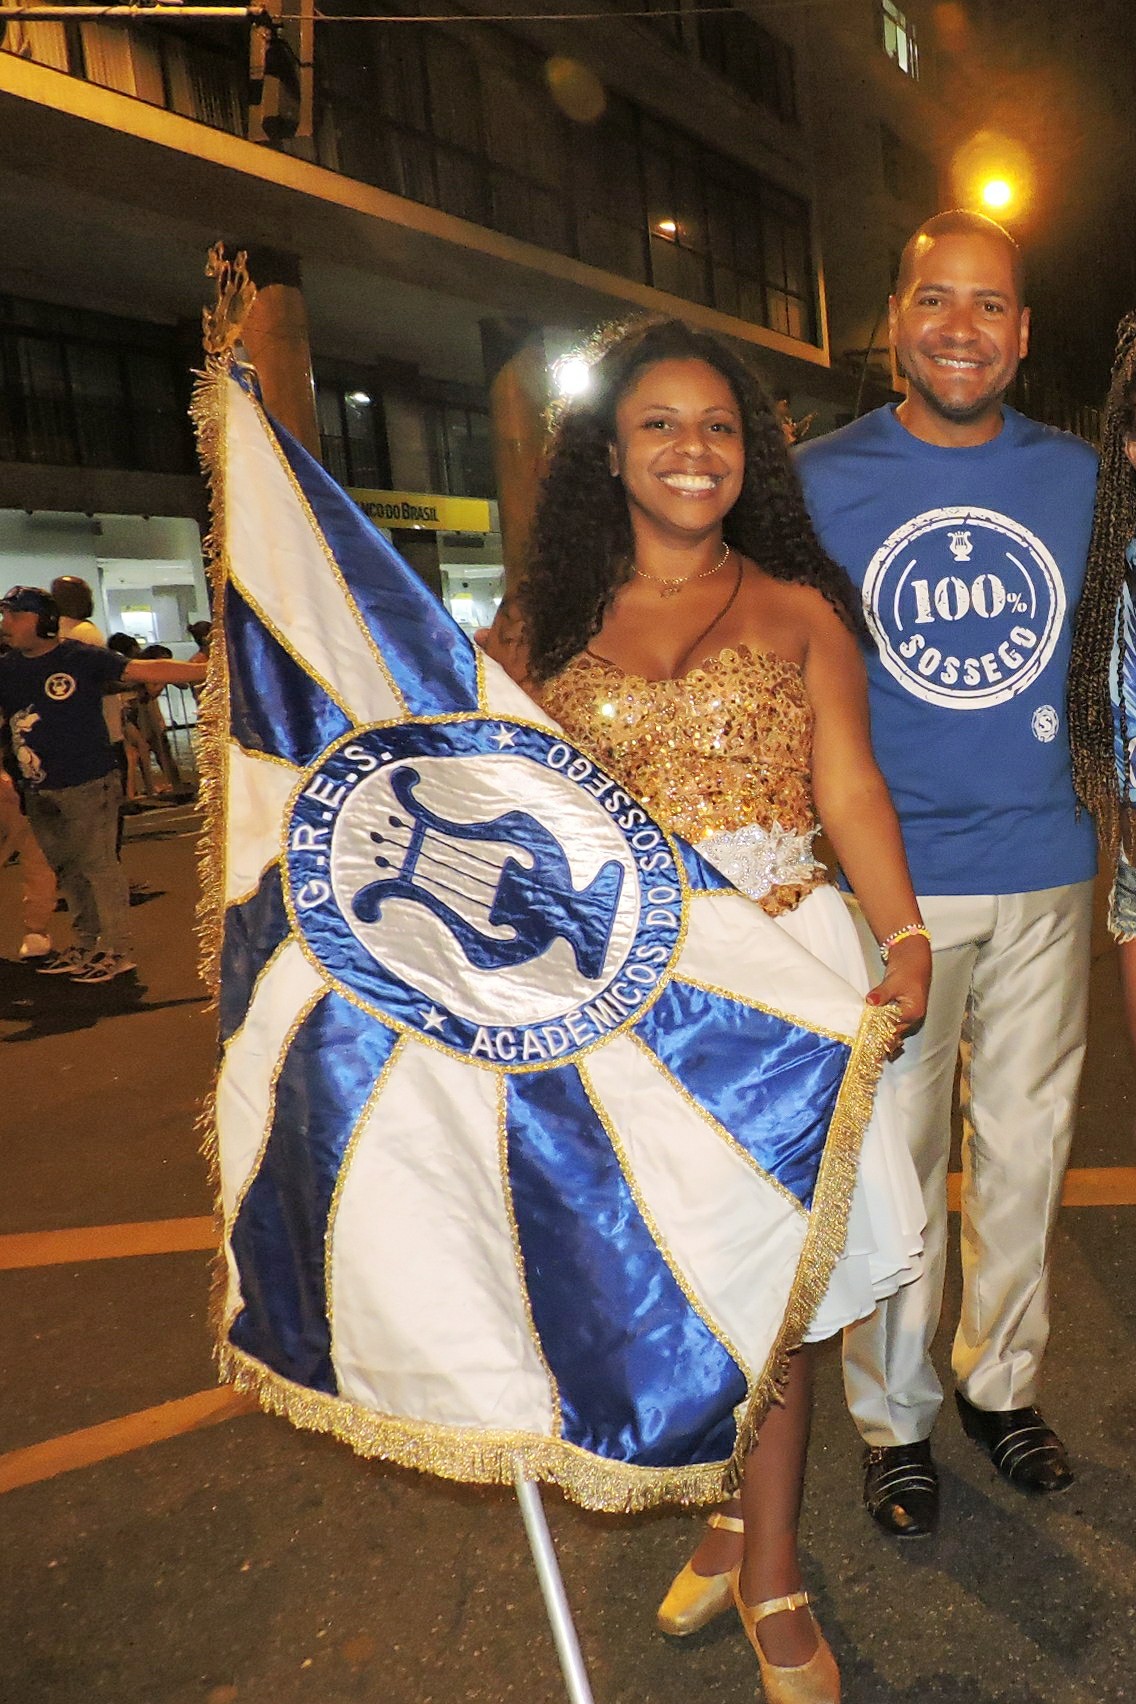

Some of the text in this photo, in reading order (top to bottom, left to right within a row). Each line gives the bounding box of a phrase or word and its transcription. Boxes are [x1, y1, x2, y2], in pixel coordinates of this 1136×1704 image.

[900, 625, 1037, 686] SOSSEGO
[547, 743, 672, 873] SOSSEGO
[646, 885, 677, 929] DO
